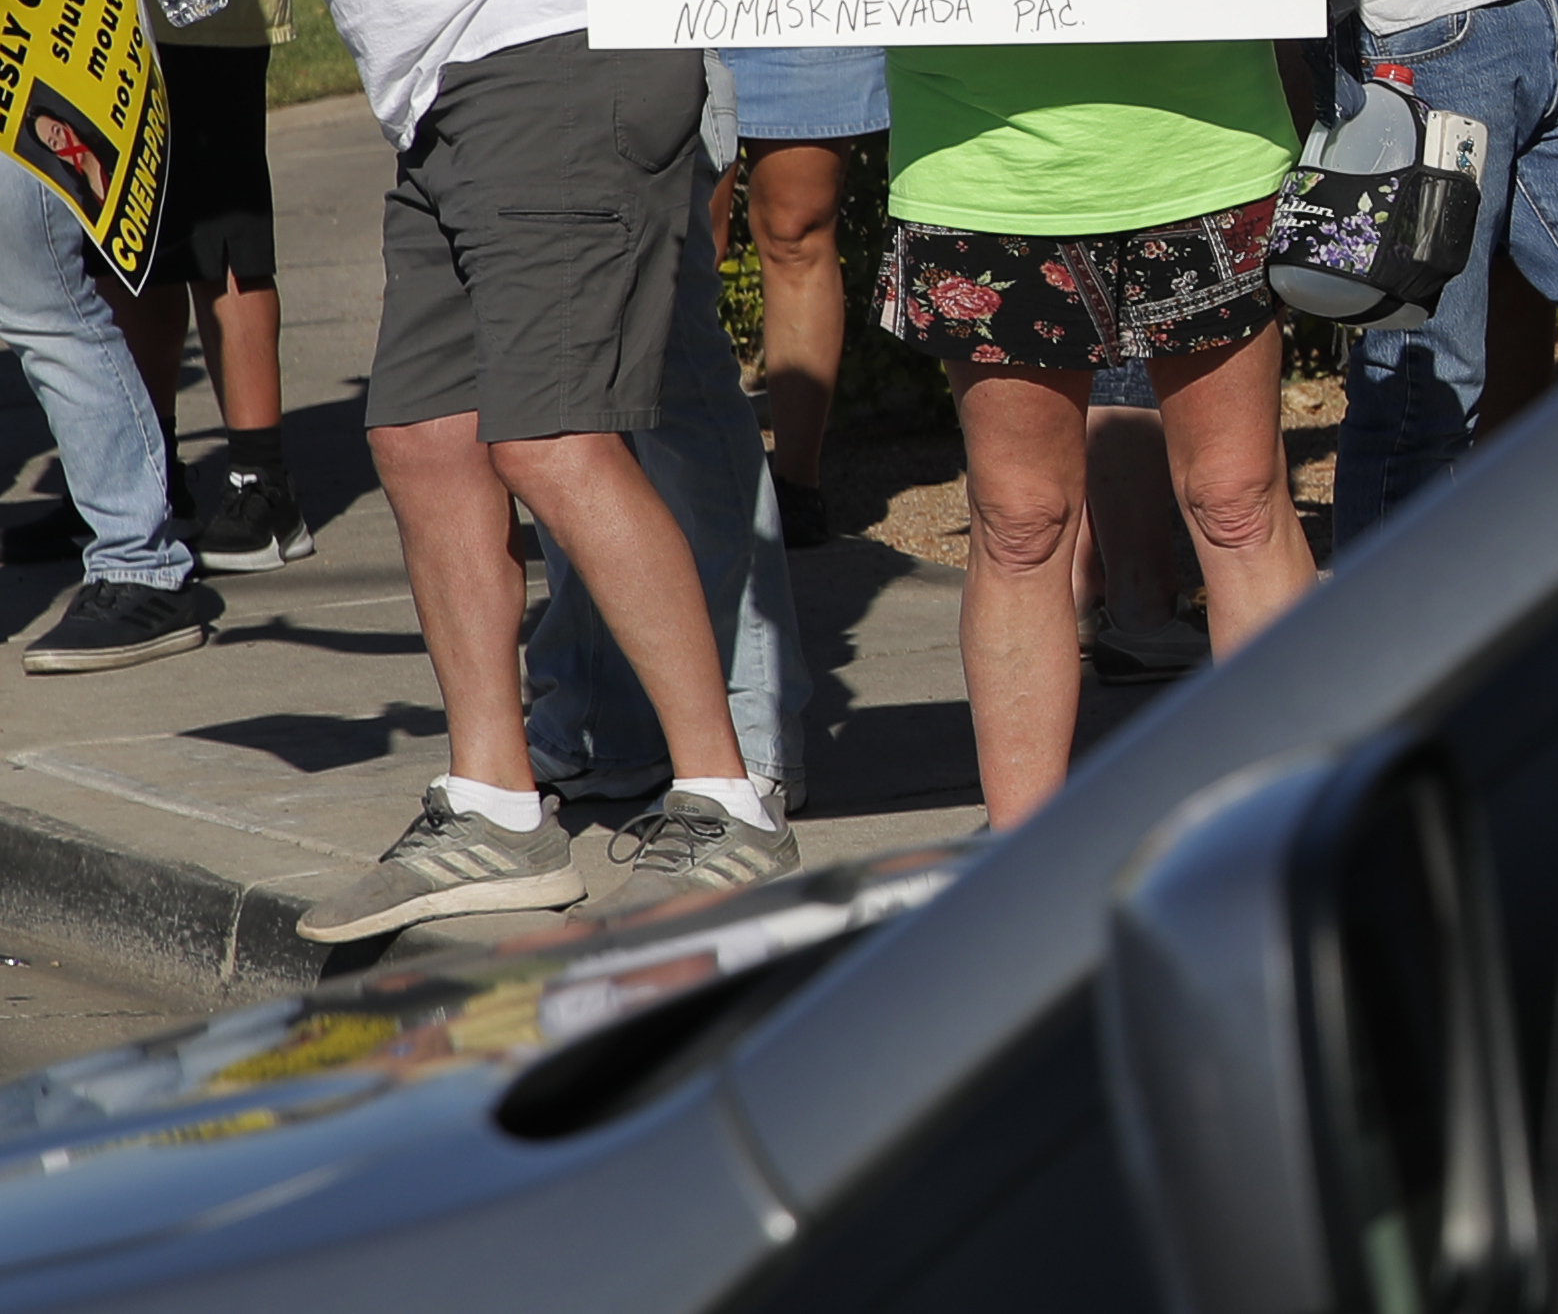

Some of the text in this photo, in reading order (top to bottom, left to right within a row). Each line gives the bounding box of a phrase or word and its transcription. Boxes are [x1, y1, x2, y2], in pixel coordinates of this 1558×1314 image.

[0, 11, 31, 133] SLY
[110, 67, 136, 130] not
[112, 78, 166, 272] COHEN=PRO
